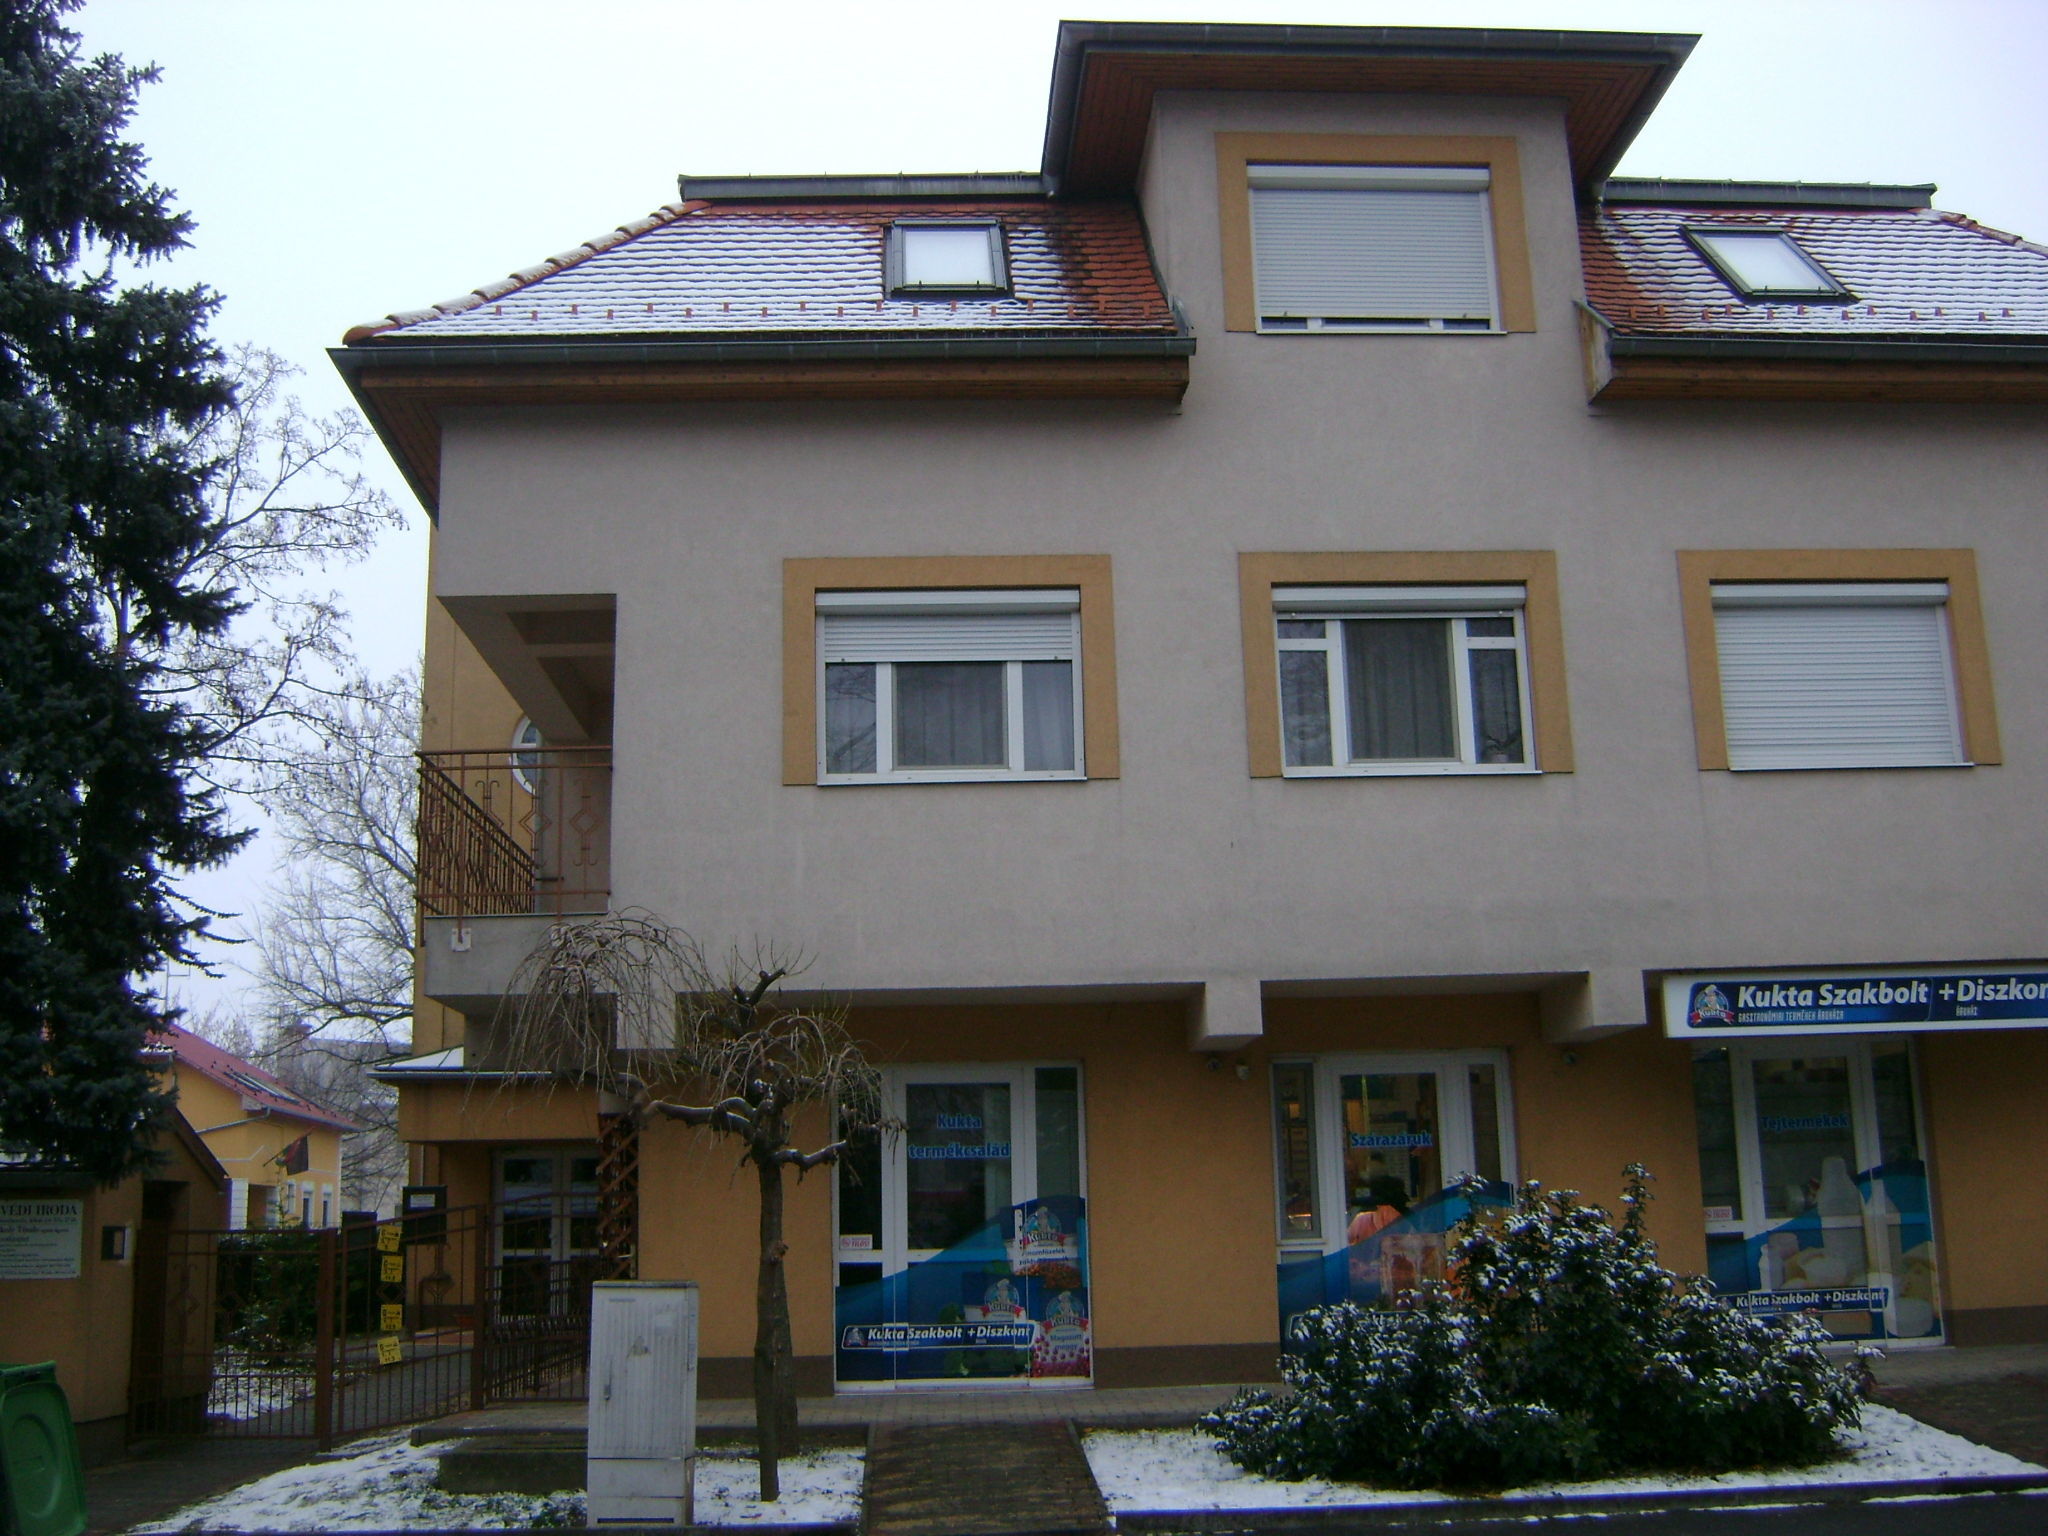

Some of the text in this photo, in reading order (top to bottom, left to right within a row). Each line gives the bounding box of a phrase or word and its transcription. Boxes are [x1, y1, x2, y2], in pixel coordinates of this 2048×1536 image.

[1737, 984, 1813, 1008] Kukta
[1818, 980, 1928, 1006] Szakbolt
[936, 1112, 982, 1128] Kukta
[1761, 1113, 1849, 1132] Tejtermékek
[1351, 1130, 1432, 1147] Szárazáruk
[908, 1142, 1010, 1158] termékcsalád
[36, 1205, 77, 1215] IRODA
[1771, 1291, 1820, 1305] Szakbolt
[868, 1327, 905, 1340] Kukta
[907, 1326, 962, 1339] Szakbolt
